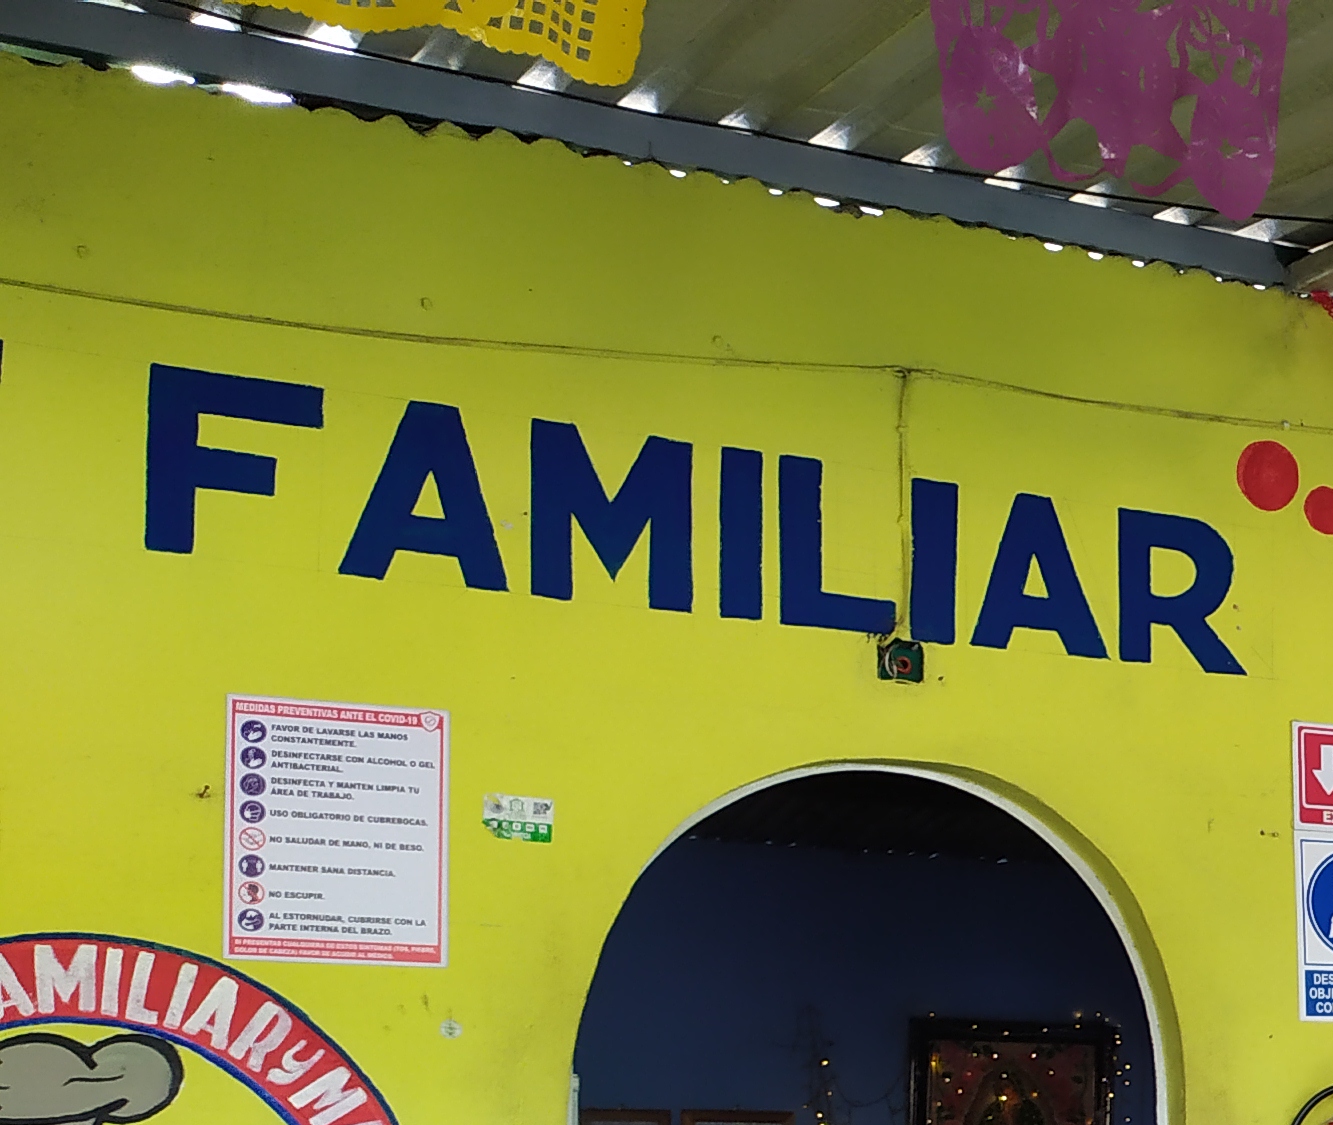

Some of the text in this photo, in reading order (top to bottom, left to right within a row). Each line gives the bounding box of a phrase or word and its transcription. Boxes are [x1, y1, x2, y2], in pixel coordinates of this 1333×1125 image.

[144, 362, 1247, 676] FAMILIAR
[236, 702, 418, 725] MEDIDAS PREVENTIVAS ANTE EL COVID-19
[271, 724, 300, 733] FAVOR
[317, 727, 355, 737] LAVARSE
[358, 730, 375, 739] LAS
[377, 731, 408, 741] MANOS
[271, 735, 357, 748] CONSTANTEMENTE.
[271, 750, 343, 762] DESINFECTARSE
[345, 755, 364, 763] CON
[367, 757, 407, 767] ALCOHOL
[419, 761, 435, 769] GEL
[271, 761, 344, 773] ANTIBACTERIAL.
[271, 777, 325, 788] DESINFECTA
[337, 781, 374, 791] MANTEN
[376, 784, 405, 793] LIMPIA
[408, 786, 420, 794] TU
[312, 791, 355, 800] TRABAJO.
[291, 811, 350, 822] OBLIGATORIO
[367, 816, 428, 827] CUBREBOCAS.
[285, 837, 326, 846] SALUDAR
[269, 863, 396, 877] MANTENER SANA DISTANCIA.
[285, 892, 325, 900] ESCUPIR.
[283, 913, 345, 923] ESTORNUDAR,
[348, 916, 392, 925] CUBRIRSE
[394, 918, 412, 926] CON
[415, 919, 426, 927] LA
[269, 923, 297, 932] PARTE
[300, 925, 339, 933] INTERNA
[361, 927, 392, 936] BRAZO.
